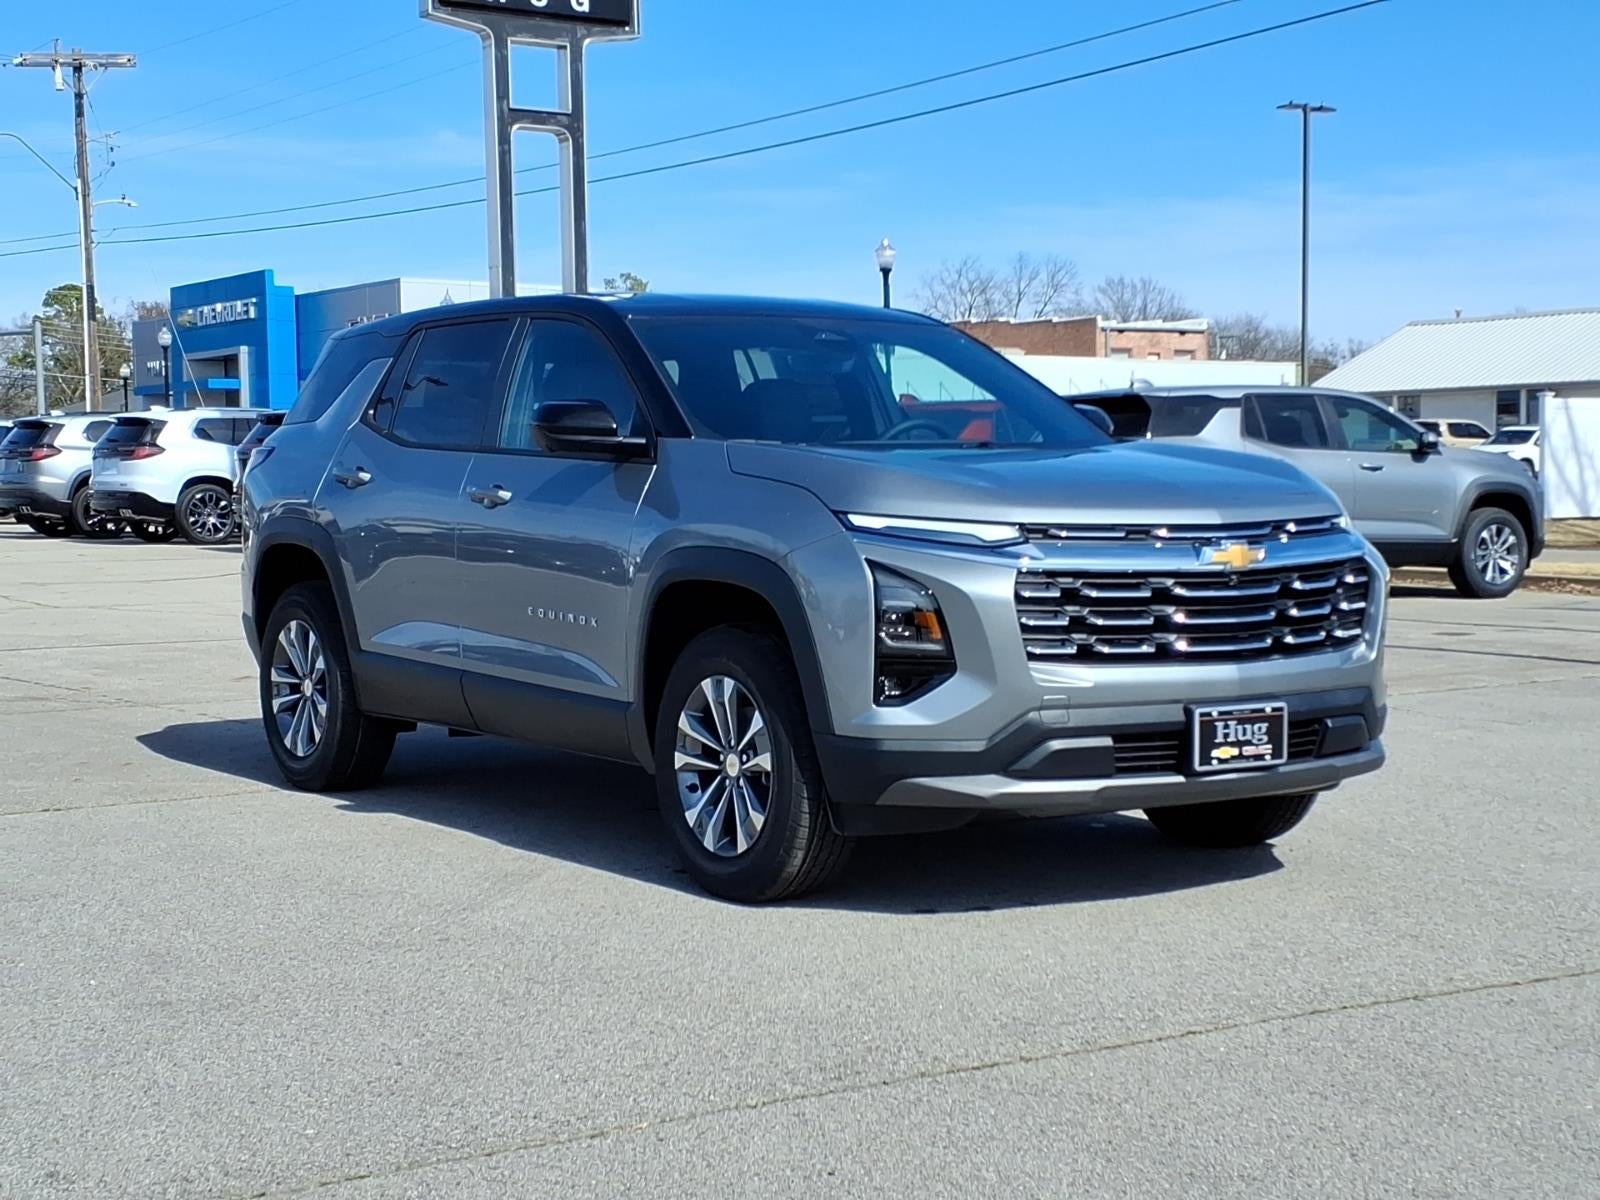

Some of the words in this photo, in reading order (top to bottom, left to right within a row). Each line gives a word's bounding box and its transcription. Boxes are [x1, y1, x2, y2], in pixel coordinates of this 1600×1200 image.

[197, 297, 257, 327] CHEVROLET
[528, 606, 598, 628] EQUINOX
[1213, 720, 1269, 745] Hug
